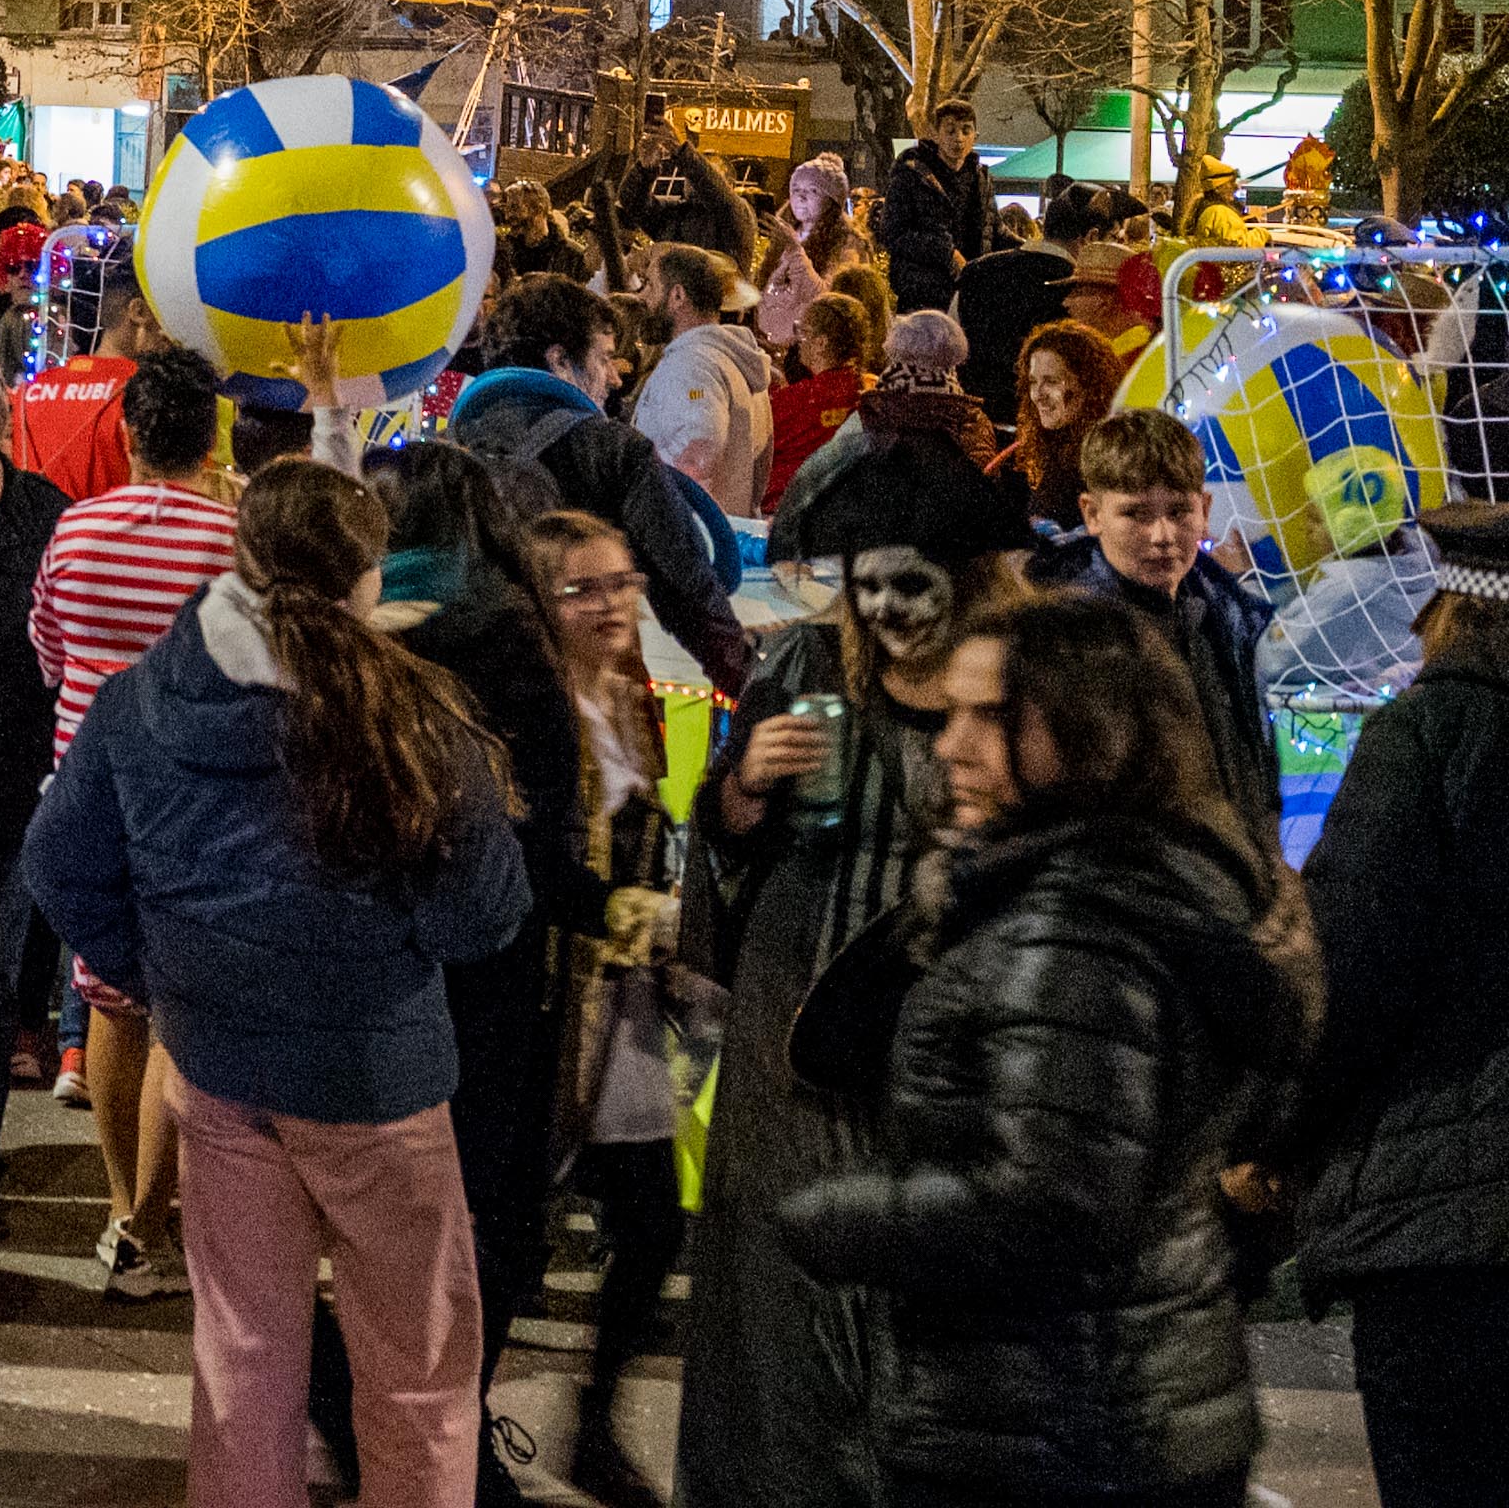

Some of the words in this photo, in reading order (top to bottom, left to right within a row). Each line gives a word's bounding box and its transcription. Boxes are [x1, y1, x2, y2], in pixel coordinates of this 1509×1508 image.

[705, 107, 787, 133] BALMES
[25, 383, 59, 402] CN
[63, 379, 117, 401] RUBÍ
